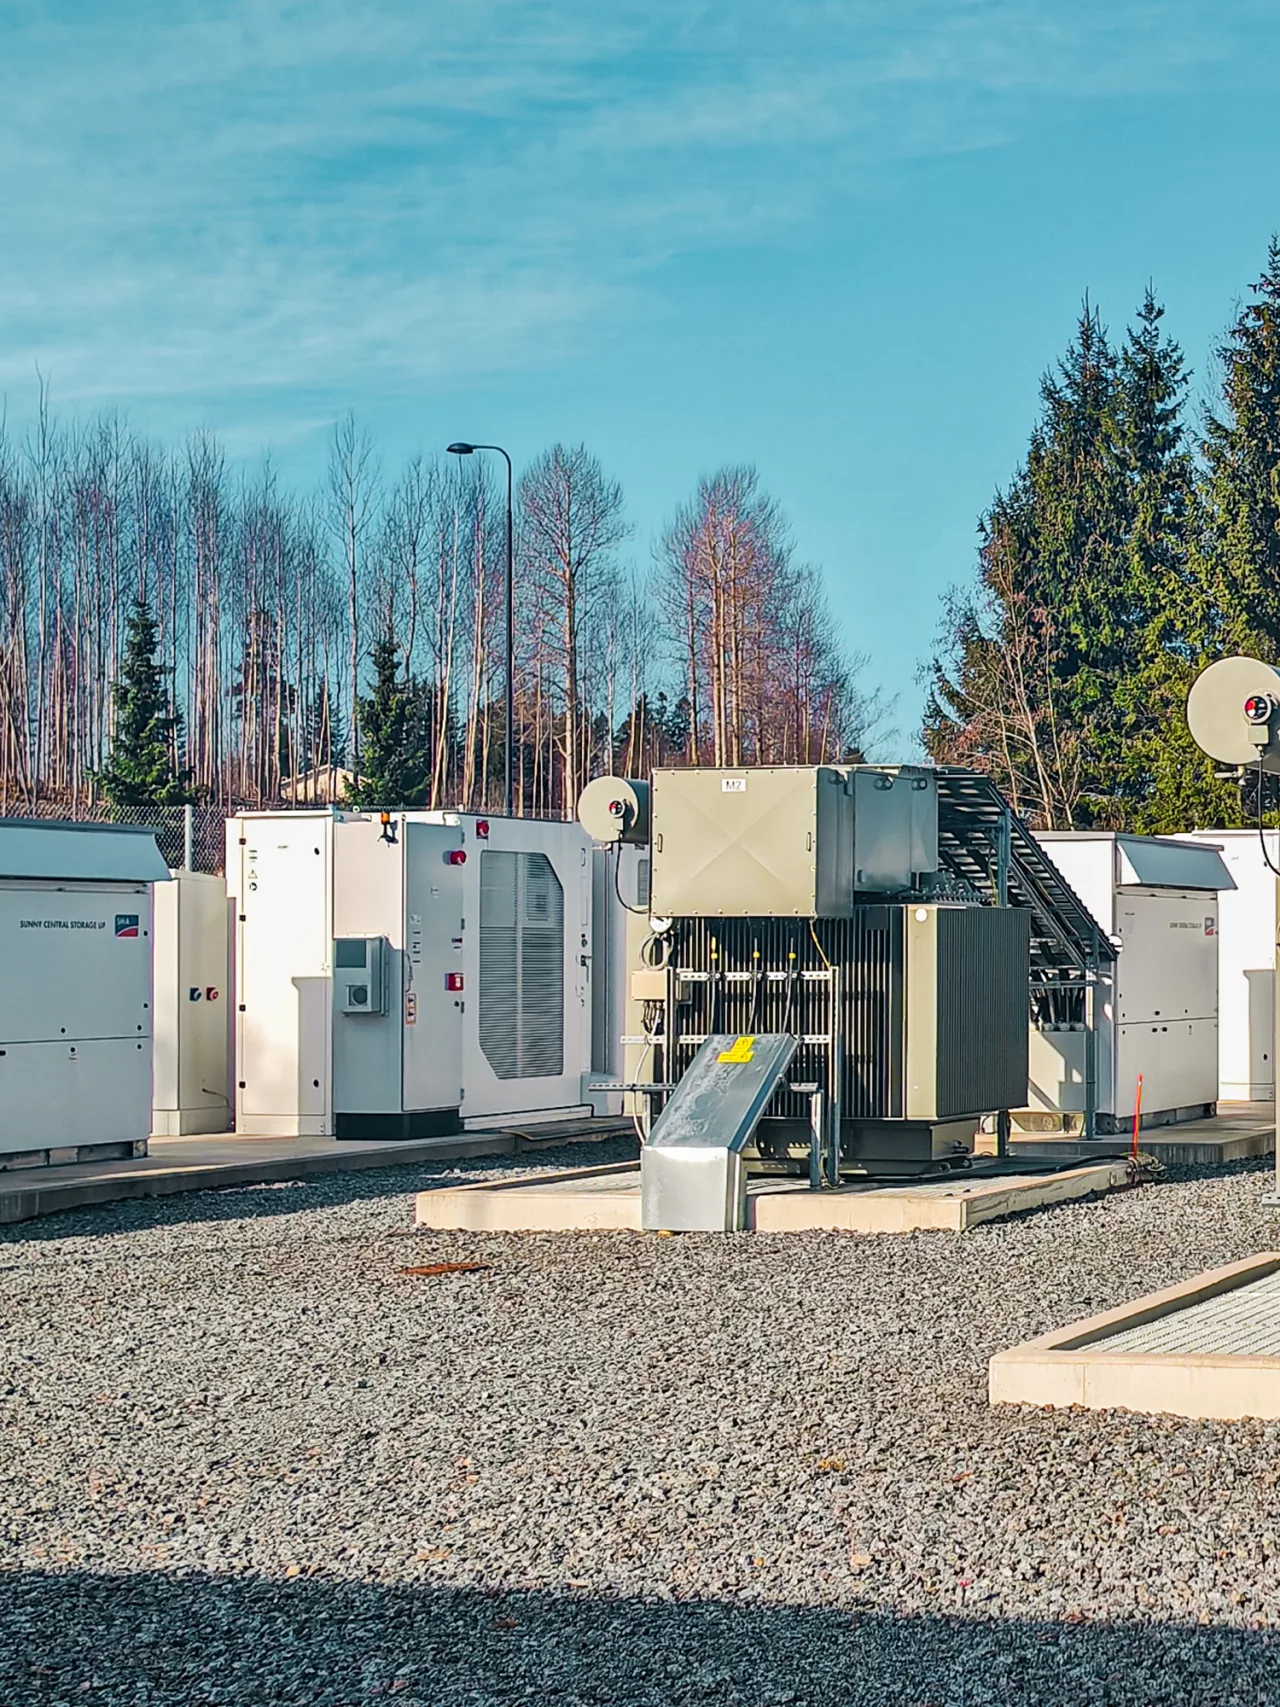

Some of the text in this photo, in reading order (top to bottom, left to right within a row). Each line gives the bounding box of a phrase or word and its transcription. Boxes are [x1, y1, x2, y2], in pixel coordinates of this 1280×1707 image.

[726, 781, 741, 790] M2
[20, 920, 42, 929] SUNNY
[43, 920, 69, 929] CENTRAL
[70, 921, 97, 930] STORAGE
